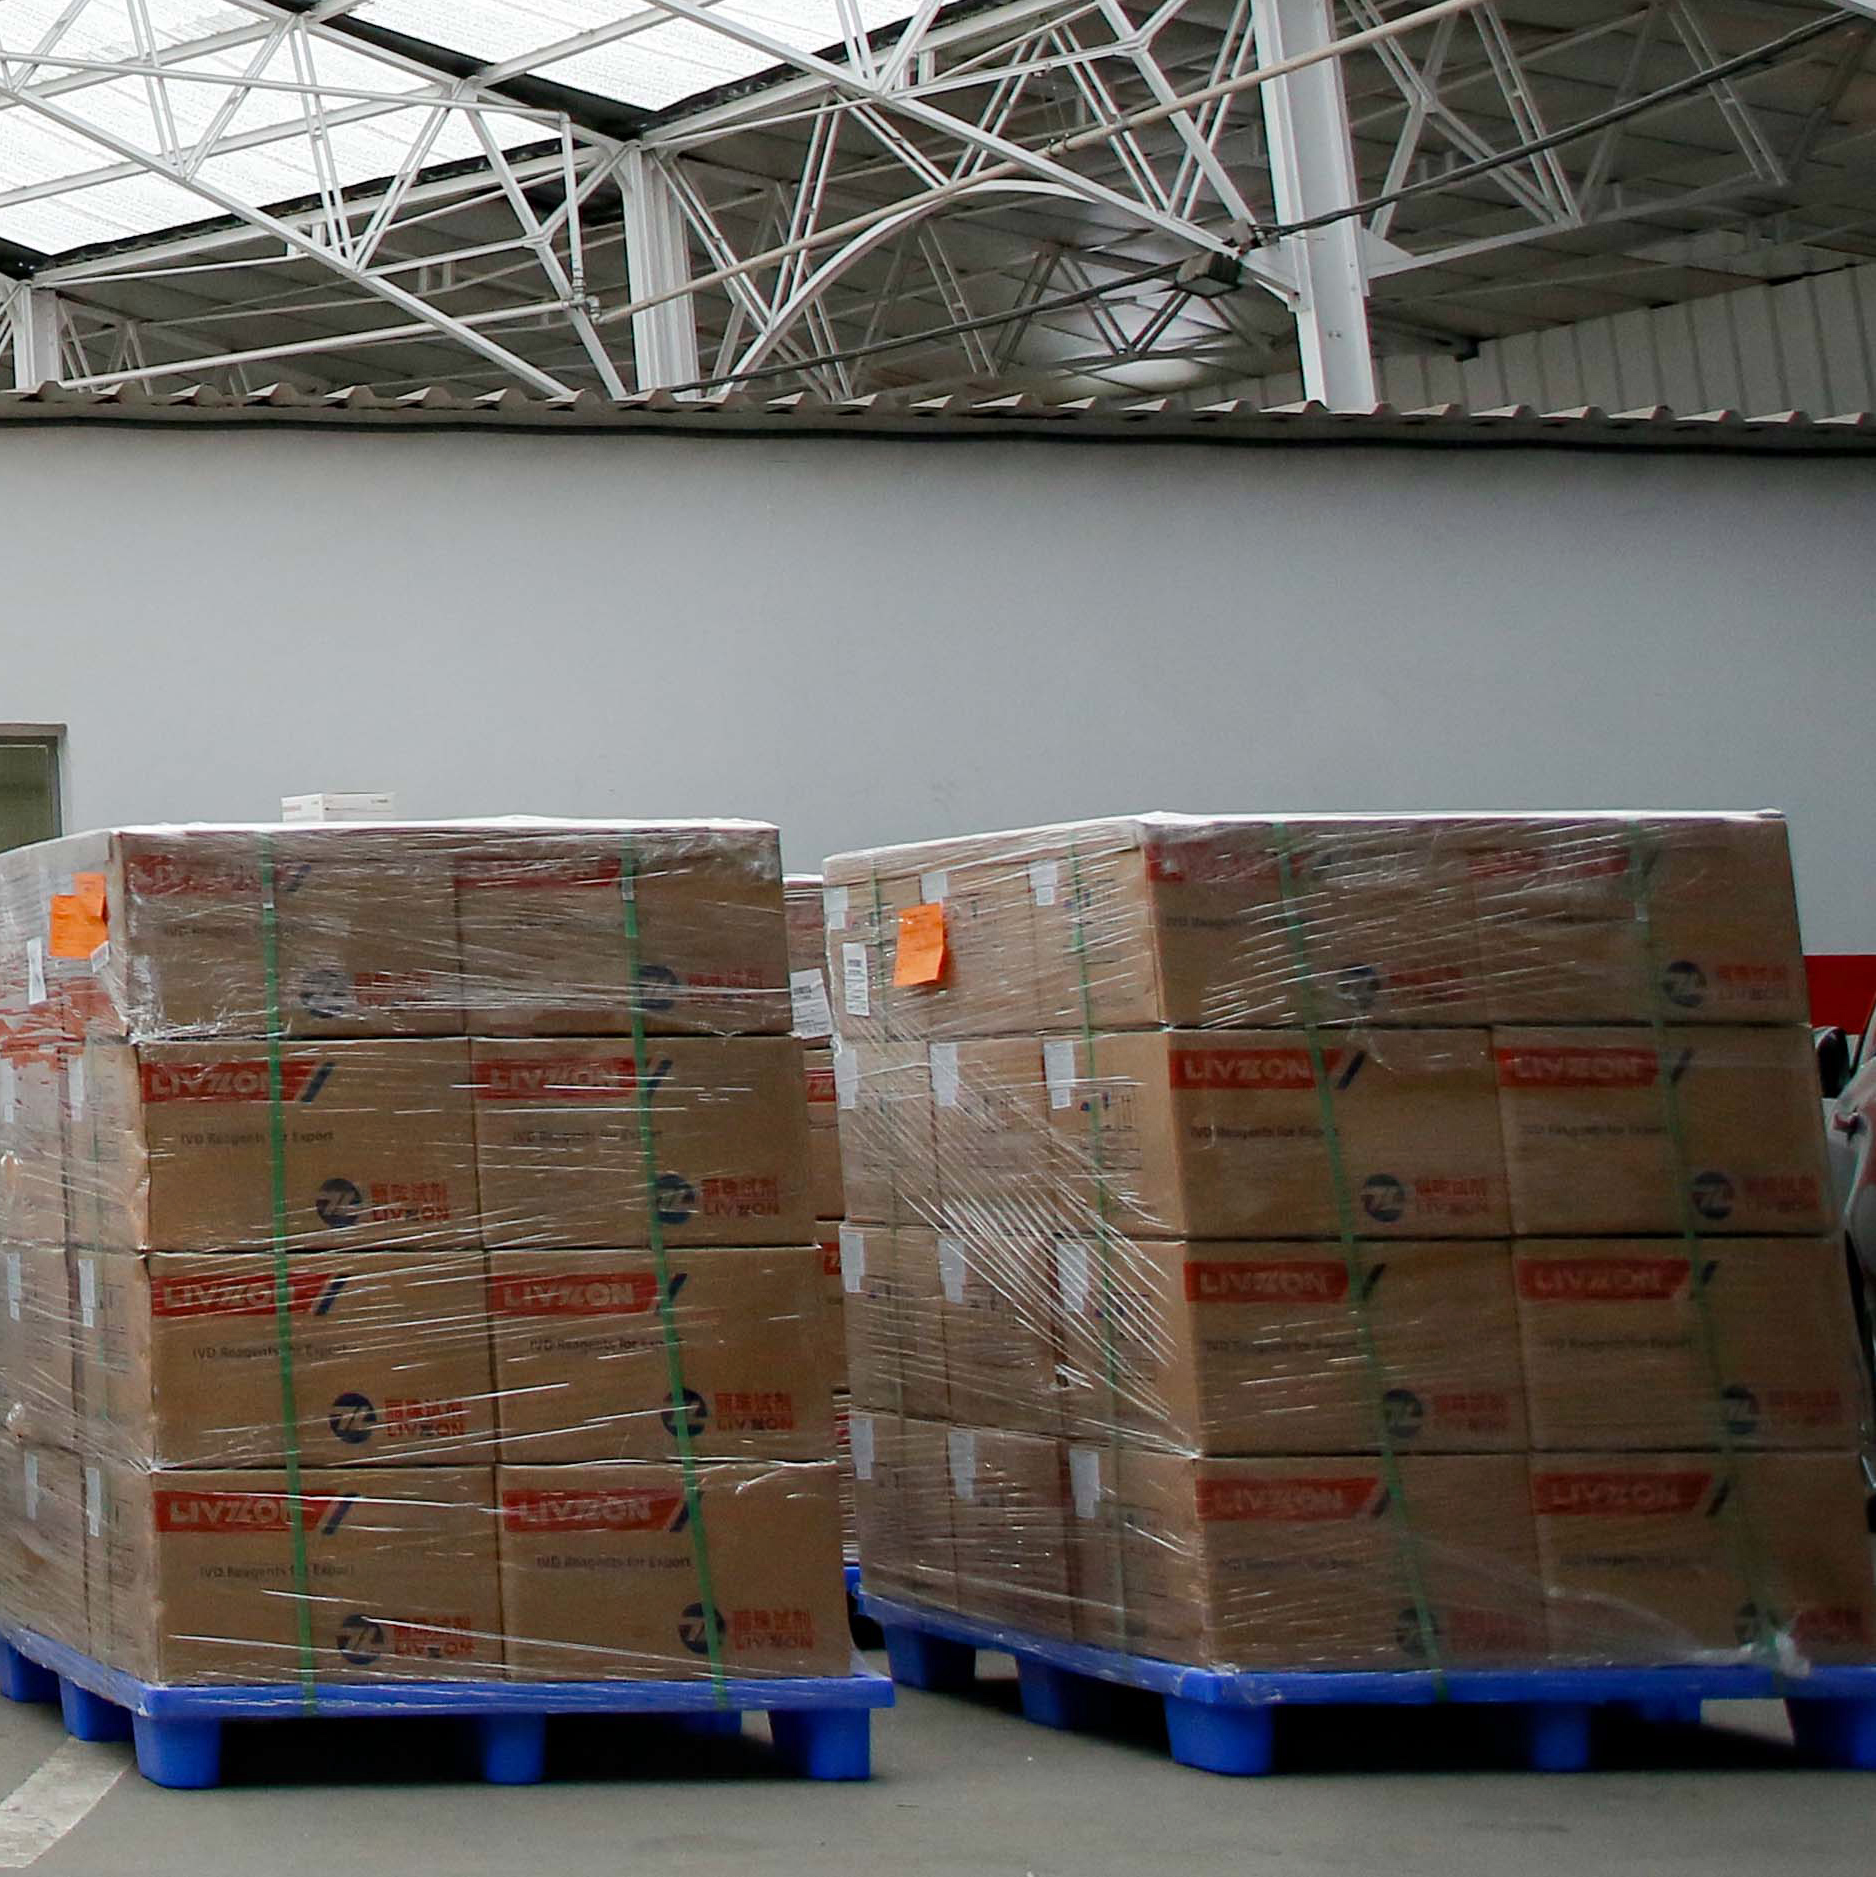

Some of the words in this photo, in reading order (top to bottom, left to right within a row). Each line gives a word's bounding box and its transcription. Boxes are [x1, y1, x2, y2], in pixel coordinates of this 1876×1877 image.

[1184, 1058, 1314, 1081] LIVZON
[1200, 1271, 1328, 1294] LIVZON
[503, 1282, 634, 1307] LIVZON
[716, 1419, 793, 1431] LIVZON
[736, 1635, 814, 1650] LIVZON
